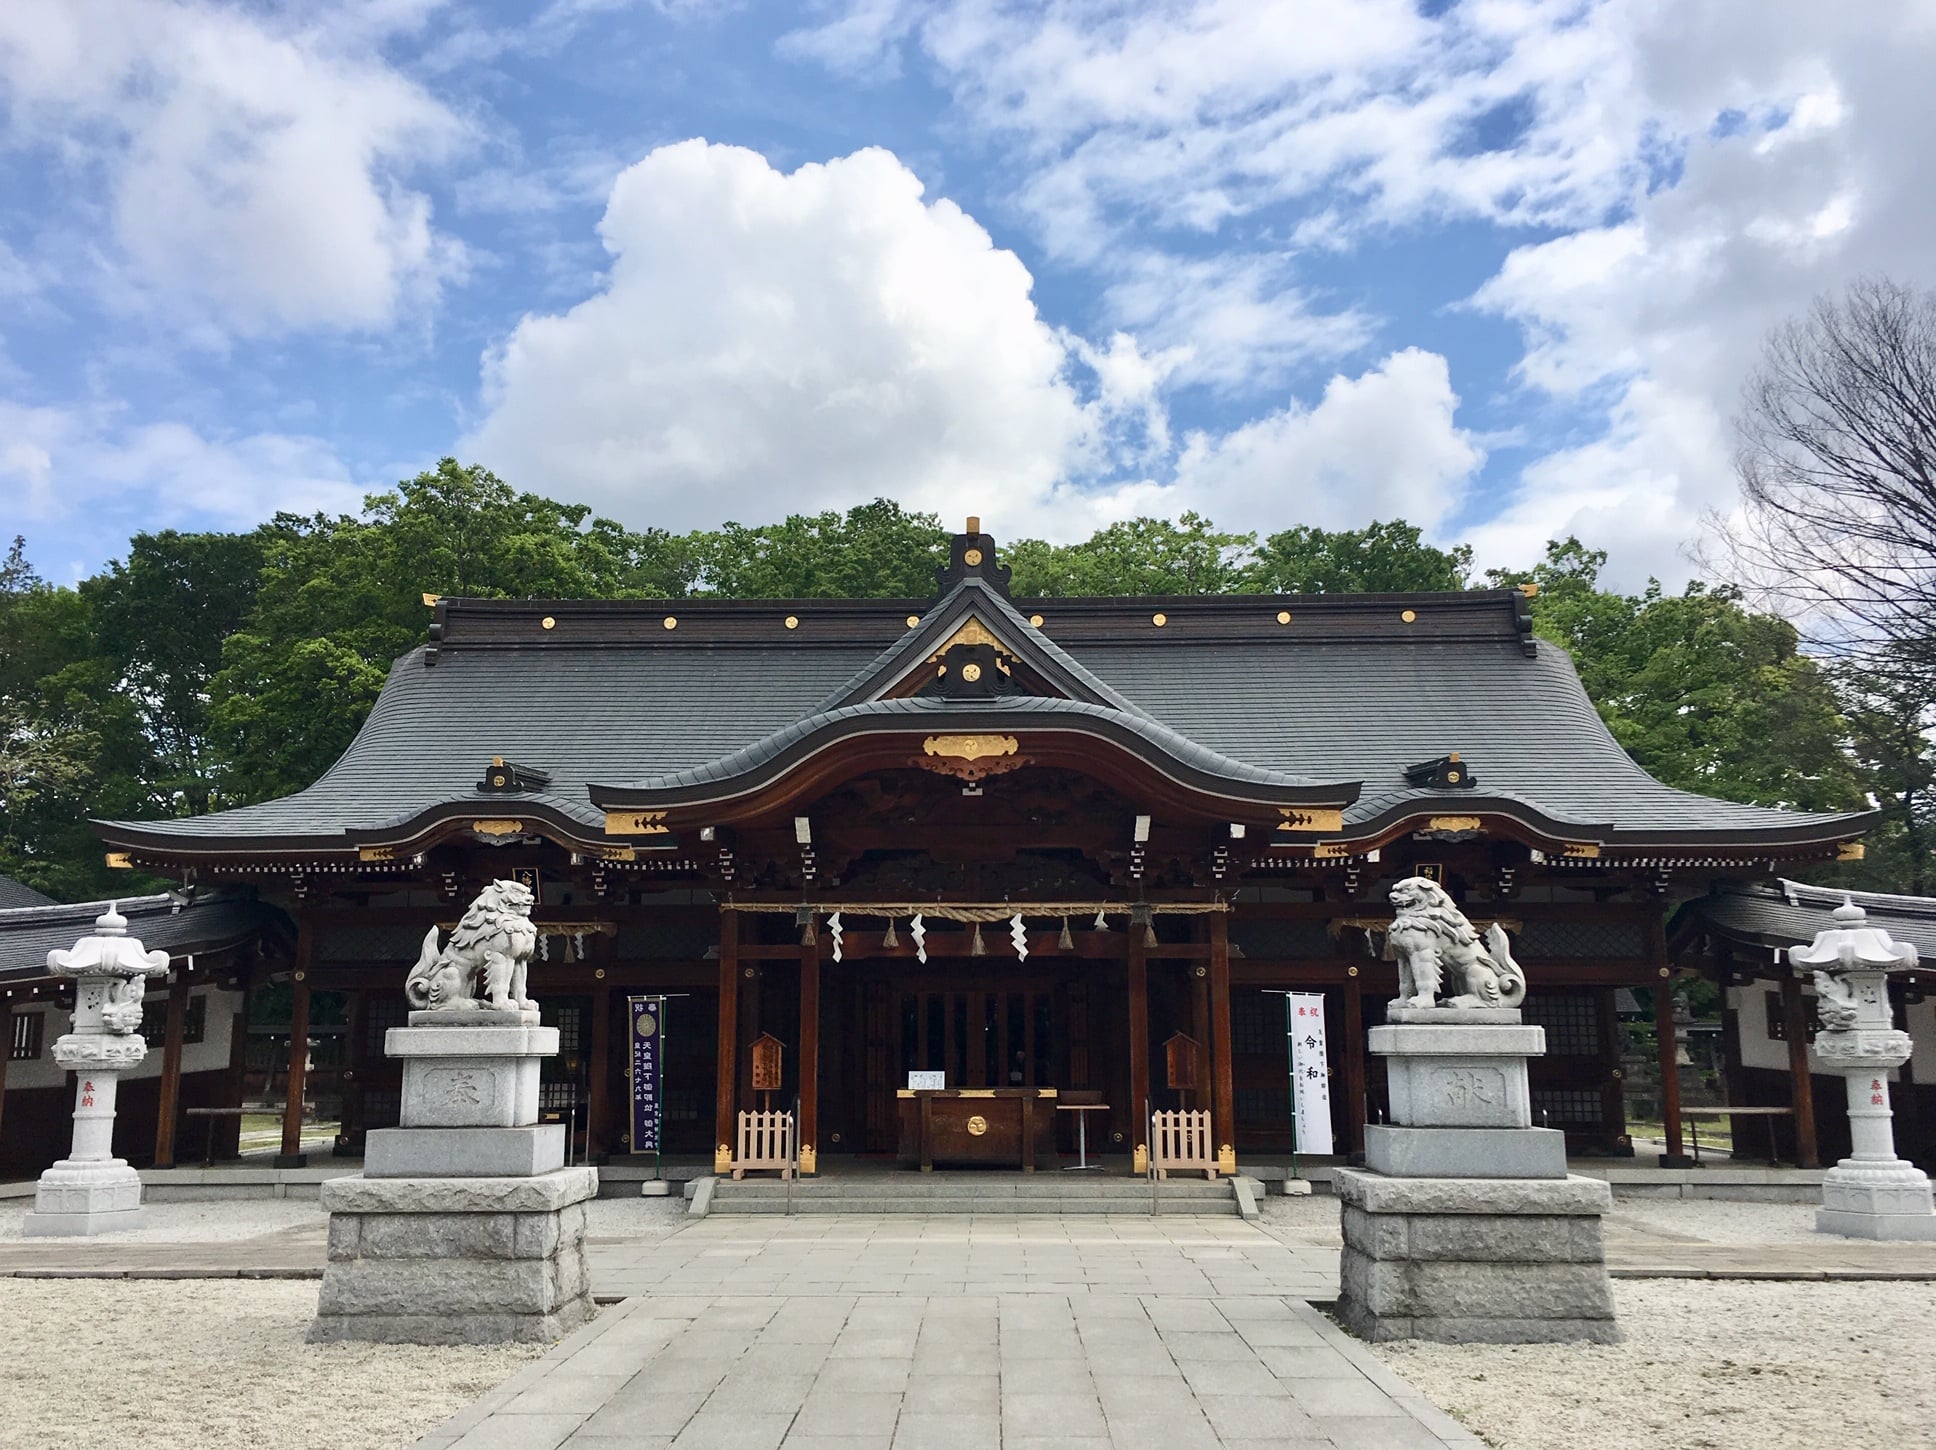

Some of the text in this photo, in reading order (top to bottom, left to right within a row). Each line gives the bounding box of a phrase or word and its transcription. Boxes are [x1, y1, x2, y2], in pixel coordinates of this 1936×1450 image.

[1298, 1007, 1319, 1017] 奉祝
[1305, 1035, 1318, 1080] 令和
[82, 1081, 95, 1107] 奉納
[440, 1071, 480, 1107] 奉
[1870, 1078, 1883, 1105] 奉納
